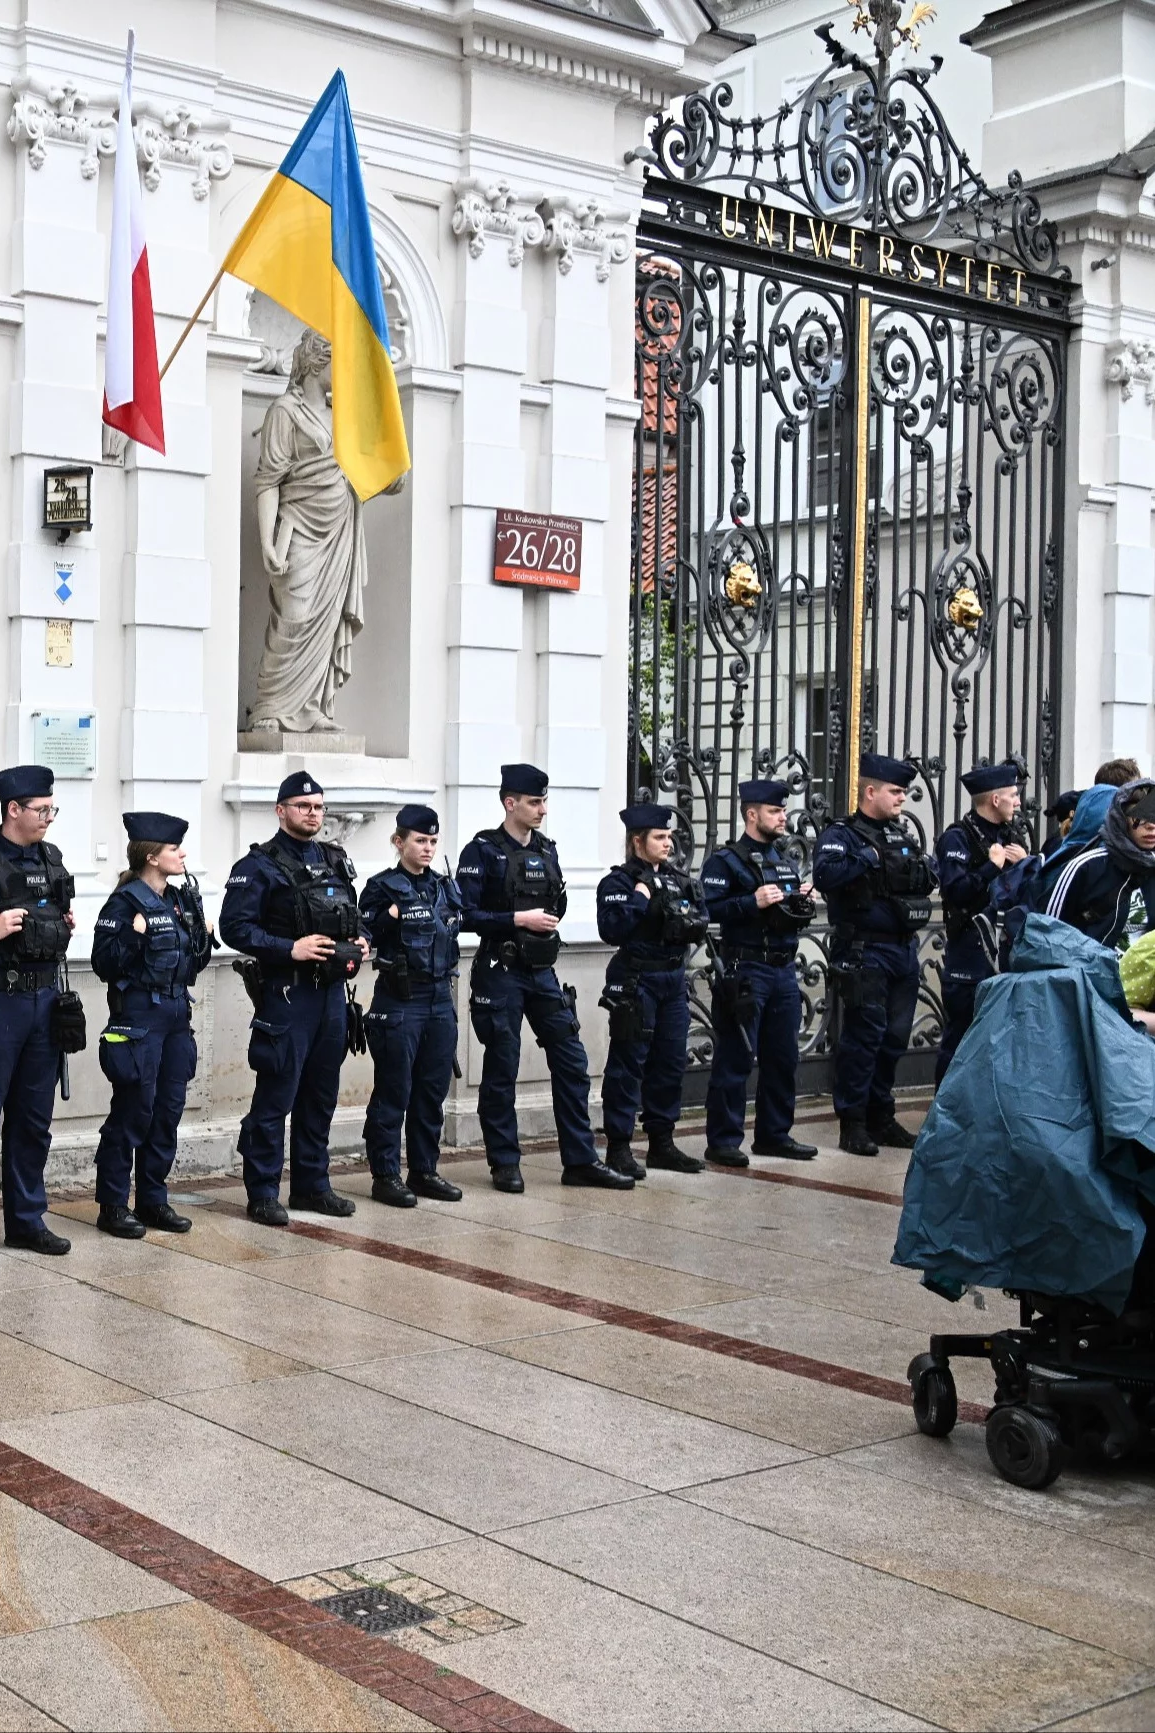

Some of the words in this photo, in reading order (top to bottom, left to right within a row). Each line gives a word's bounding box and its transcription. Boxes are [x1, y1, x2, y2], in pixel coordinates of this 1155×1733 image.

[720, 196, 1027, 306] UNIWERSYTET
[515, 514, 547, 526] Krakowskie
[504, 529, 576, 573] 26/28
[822, 844, 844, 852] POLICJA
[947, 851, 966, 860] POLICJA
[26, 875, 47, 884] POLICJA
[526, 871, 545, 879] POLICJA
[704, 877, 726, 886] POLICJA
[605, 894, 628, 902] POLICJA
[401, 910, 431, 920] POLICJA
[909, 910, 929, 919] POLICJA
[148, 916, 173, 926] POLICJA
